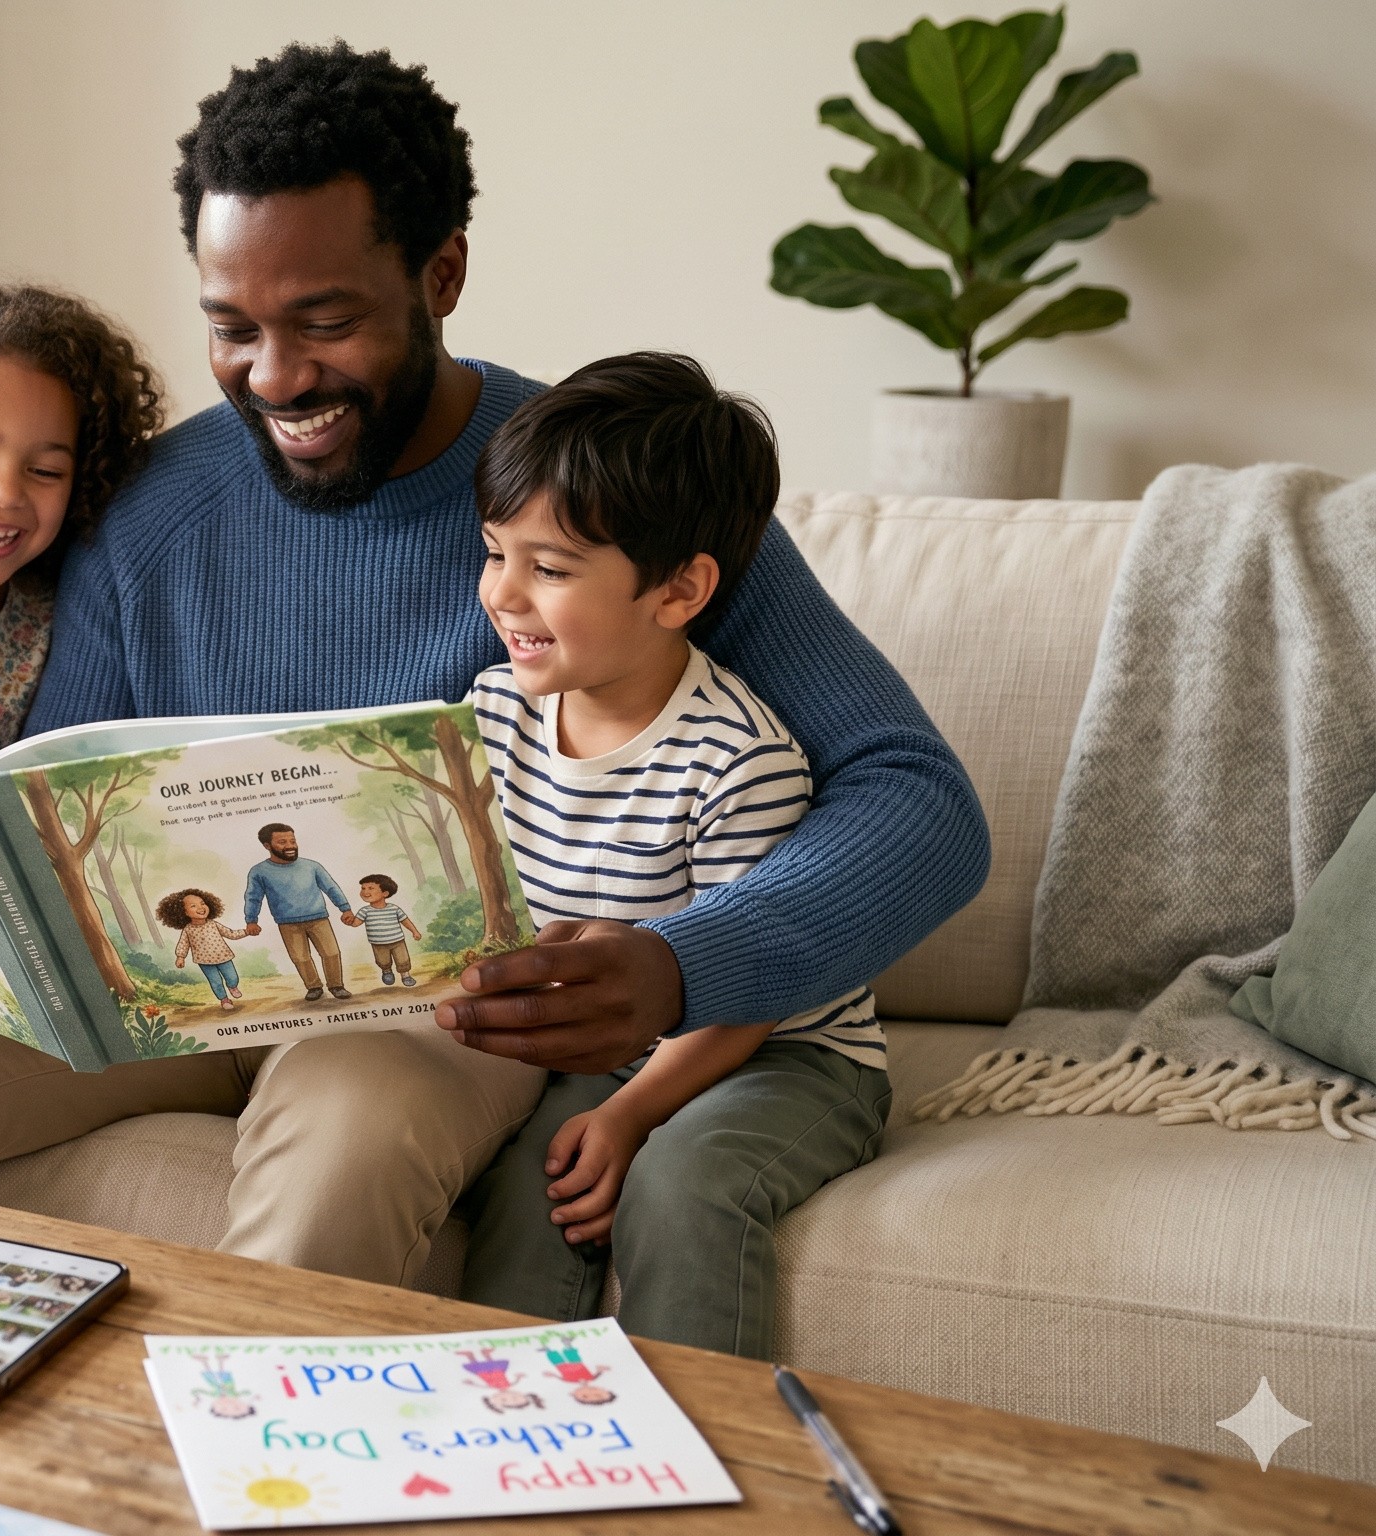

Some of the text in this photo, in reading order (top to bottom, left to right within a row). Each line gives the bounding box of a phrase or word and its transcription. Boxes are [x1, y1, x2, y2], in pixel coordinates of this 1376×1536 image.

[160, 783, 192, 799] OUR
[198, 772, 264, 793] JOURNEY
[271, 764, 338, 782] BEGAN...
[216, 1026, 240, 1037] OUR
[244, 1017, 313, 1034] ADVENTURES
[327, 1009, 378, 1026] FATHER'S
[382, 1006, 404, 1017] DAY
[280, 1361, 437, 1399] Dad!
[261, 1418, 636, 1462] Father's Day
[498, 1462, 689, 1499] Happy
